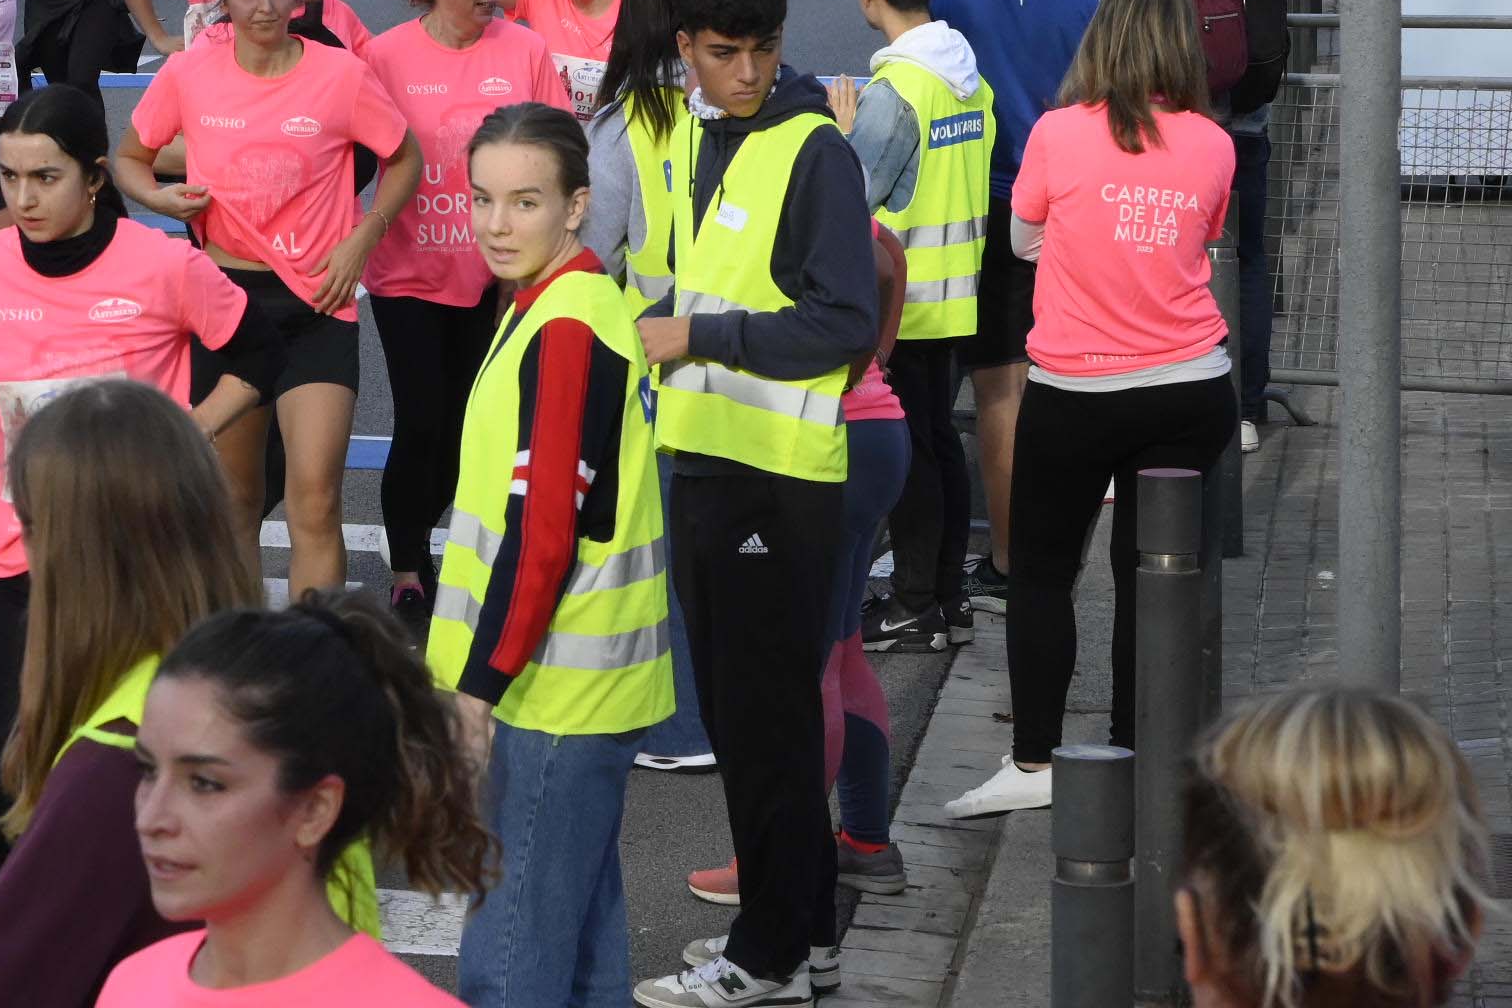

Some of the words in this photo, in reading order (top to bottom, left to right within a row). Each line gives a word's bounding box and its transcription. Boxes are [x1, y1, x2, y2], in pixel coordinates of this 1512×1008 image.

[406, 83, 448, 95] OYSHO
[575, 91, 593, 103] 01
[199, 114, 246, 129] OYSHO
[416, 195, 468, 215] DOR
[1101, 183, 1199, 211] CARRERA
[1119, 204, 1144, 224] DE
[1154, 207, 1177, 227] LA
[416, 223, 476, 245] SUM
[1114, 223, 1178, 246] MUJER
[738, 545, 768, 554] adidas
